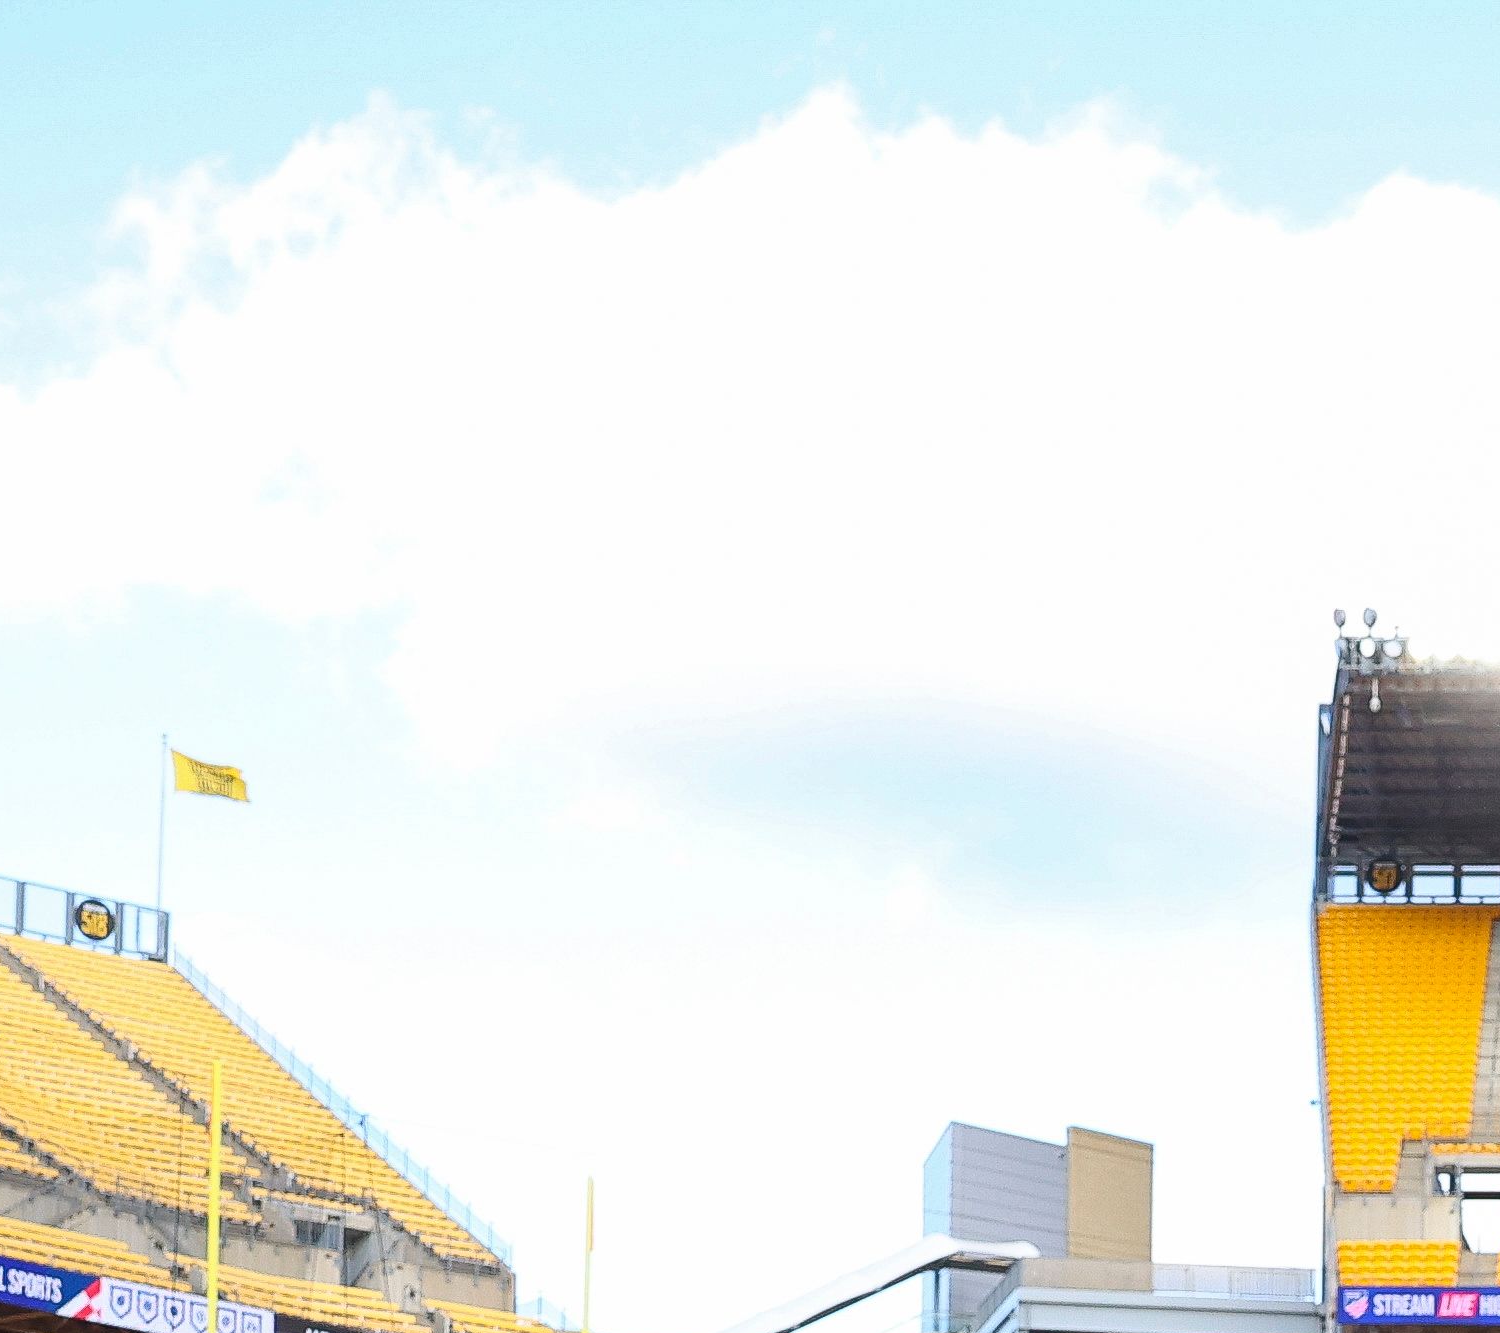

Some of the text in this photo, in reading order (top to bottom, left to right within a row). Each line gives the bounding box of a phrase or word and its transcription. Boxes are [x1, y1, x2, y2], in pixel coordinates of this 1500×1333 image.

[7, 1268, 62, 1303] SPORTS
[1372, 1293, 1435, 1317] STREAM
[1439, 1293, 1478, 1317] LIVE
